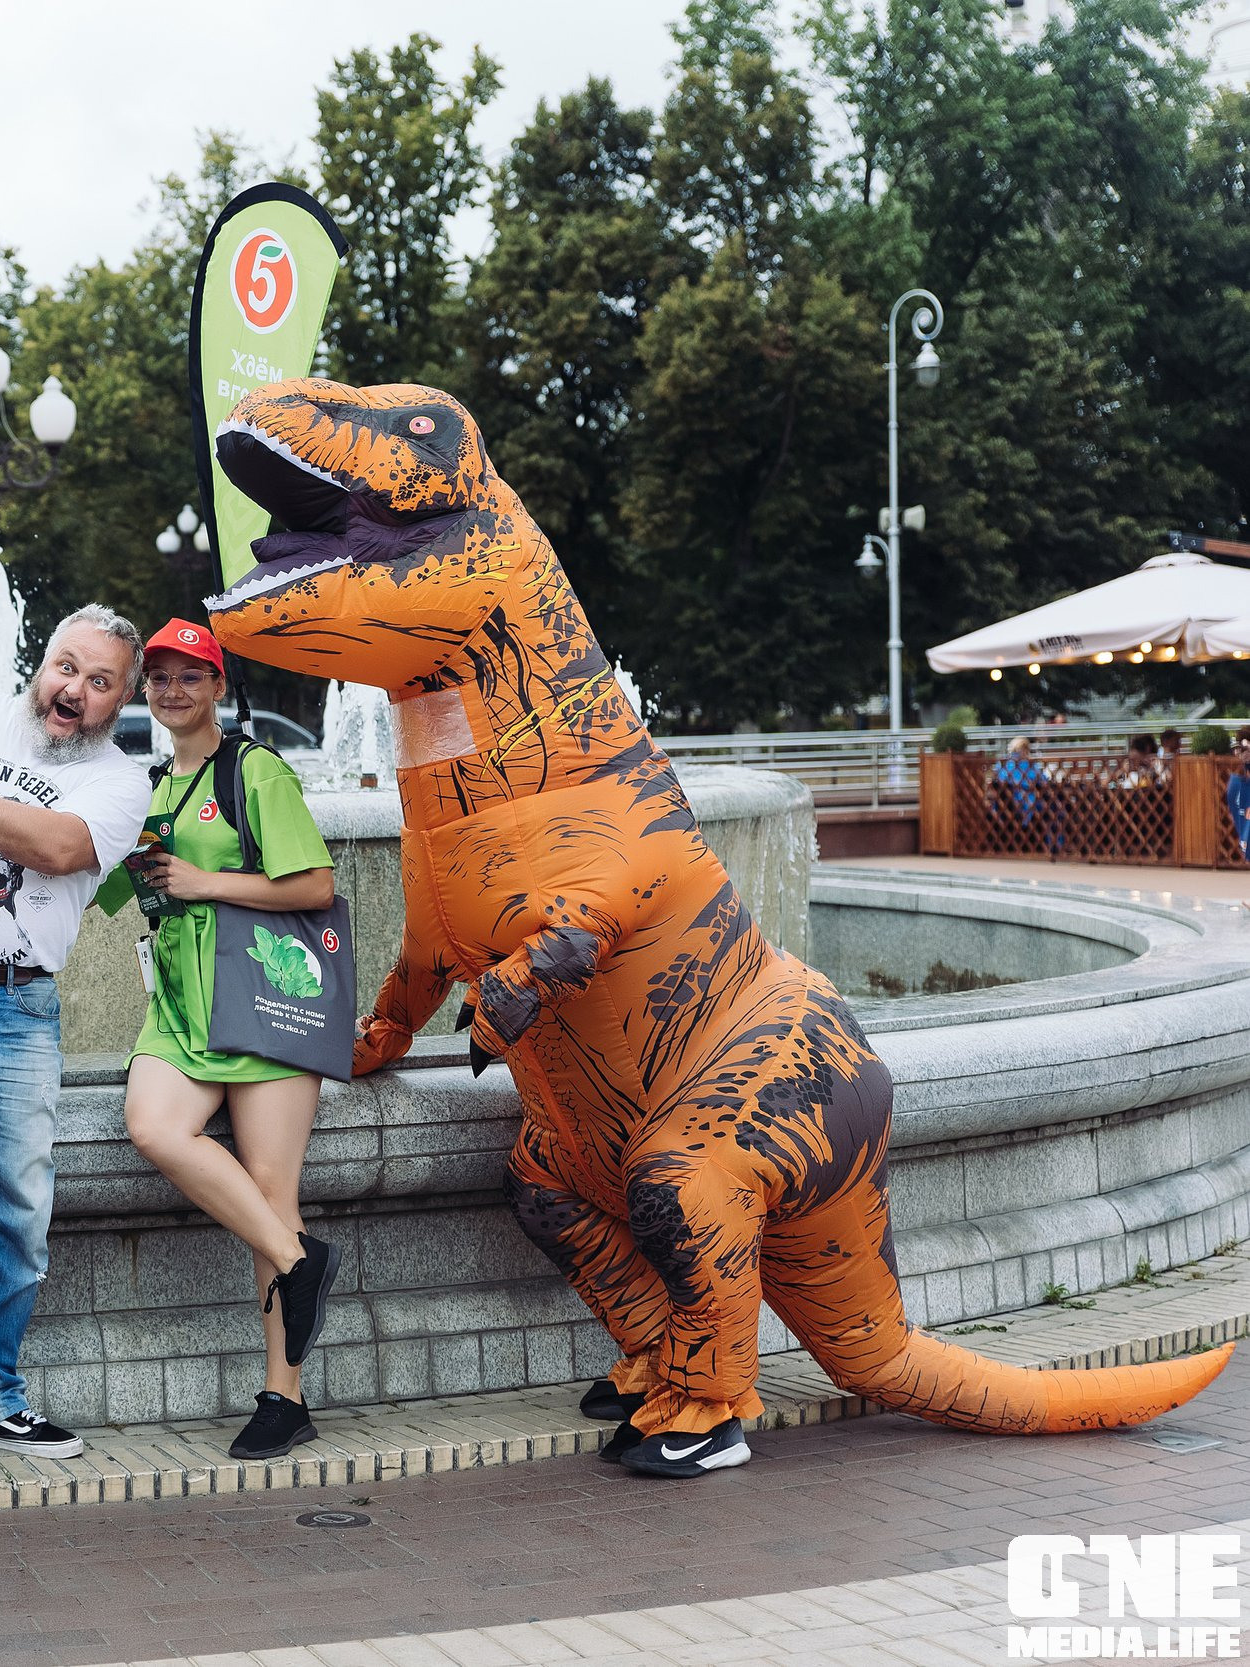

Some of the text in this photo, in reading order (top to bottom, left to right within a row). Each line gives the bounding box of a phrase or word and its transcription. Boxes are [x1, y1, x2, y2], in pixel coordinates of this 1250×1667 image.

[254, 1004, 284, 1017] любовь
[291, 1015, 325, 1028] природе
[305, 1010, 326, 1020] нами
